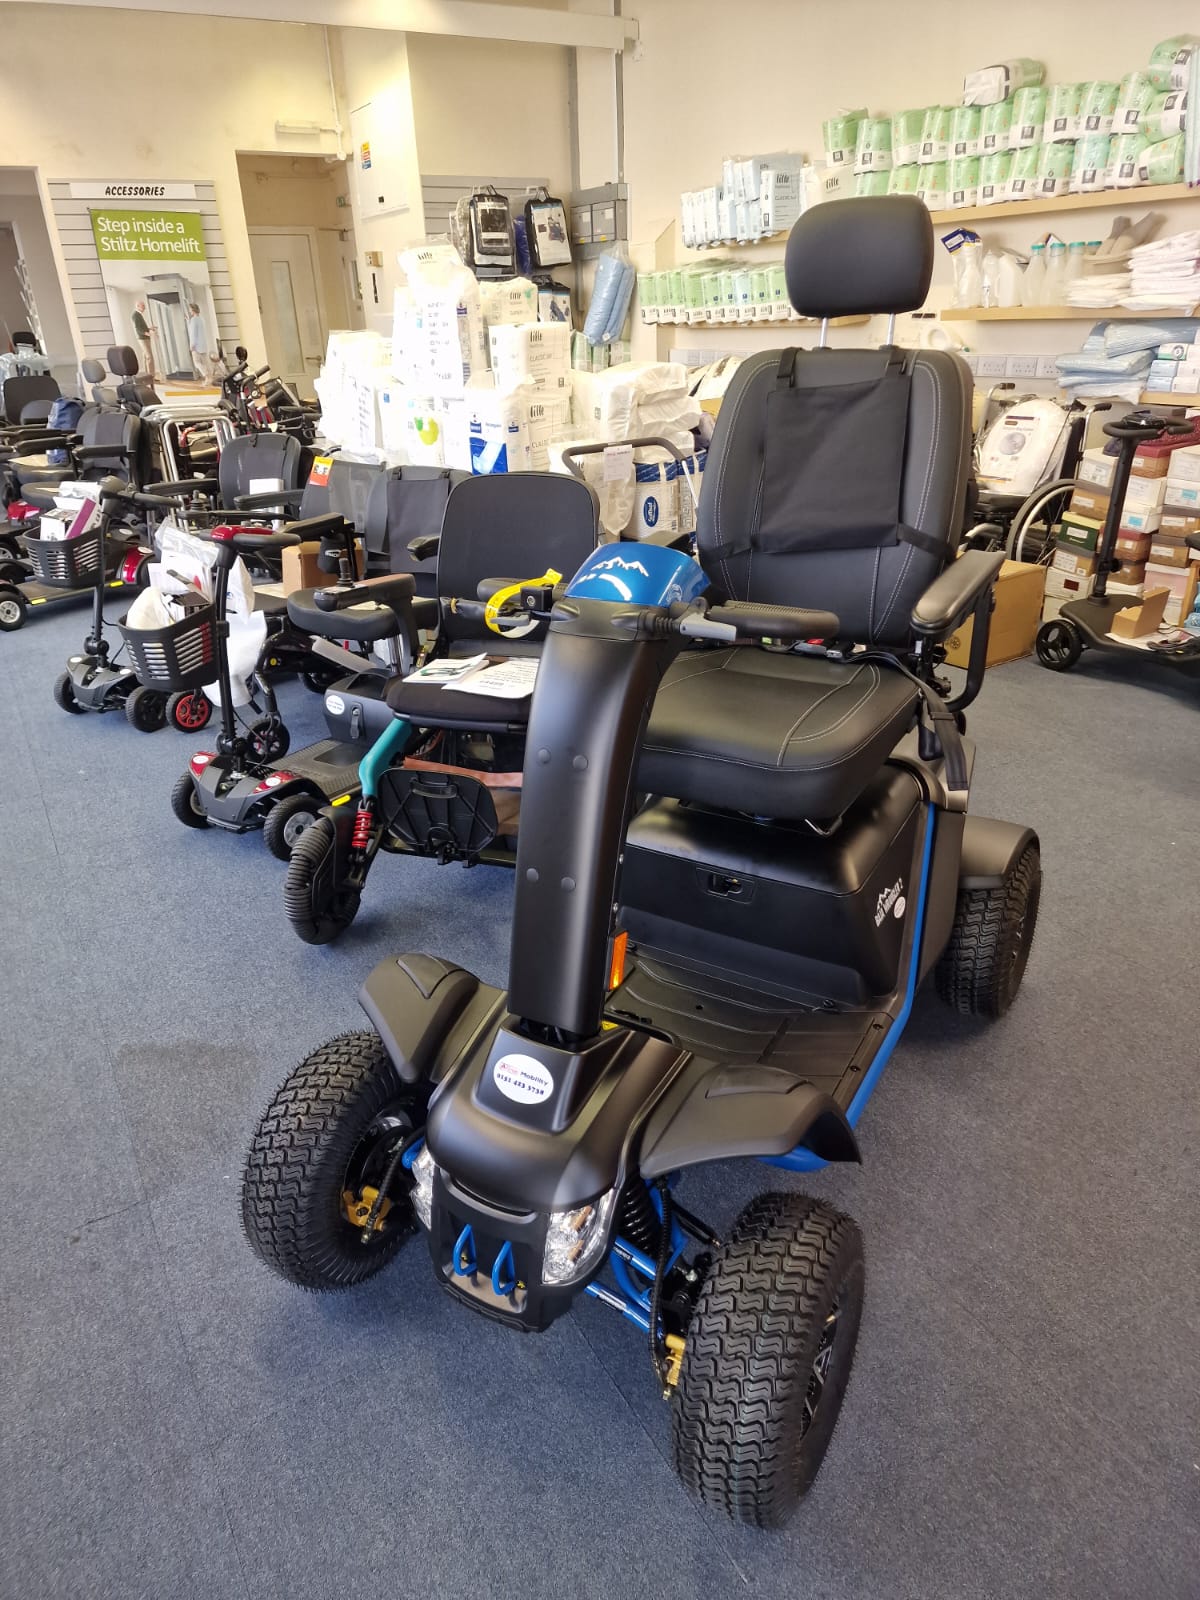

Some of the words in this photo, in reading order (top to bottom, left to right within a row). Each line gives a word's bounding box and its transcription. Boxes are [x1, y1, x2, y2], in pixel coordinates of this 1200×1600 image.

[105, 186, 165, 196] ACCESSORIES
[97, 217, 130, 235] Step
[132, 217, 174, 233] inside
[176, 222, 185, 234] a
[101, 236, 138, 252] Stiltz
[140, 237, 201, 253] Homelift
